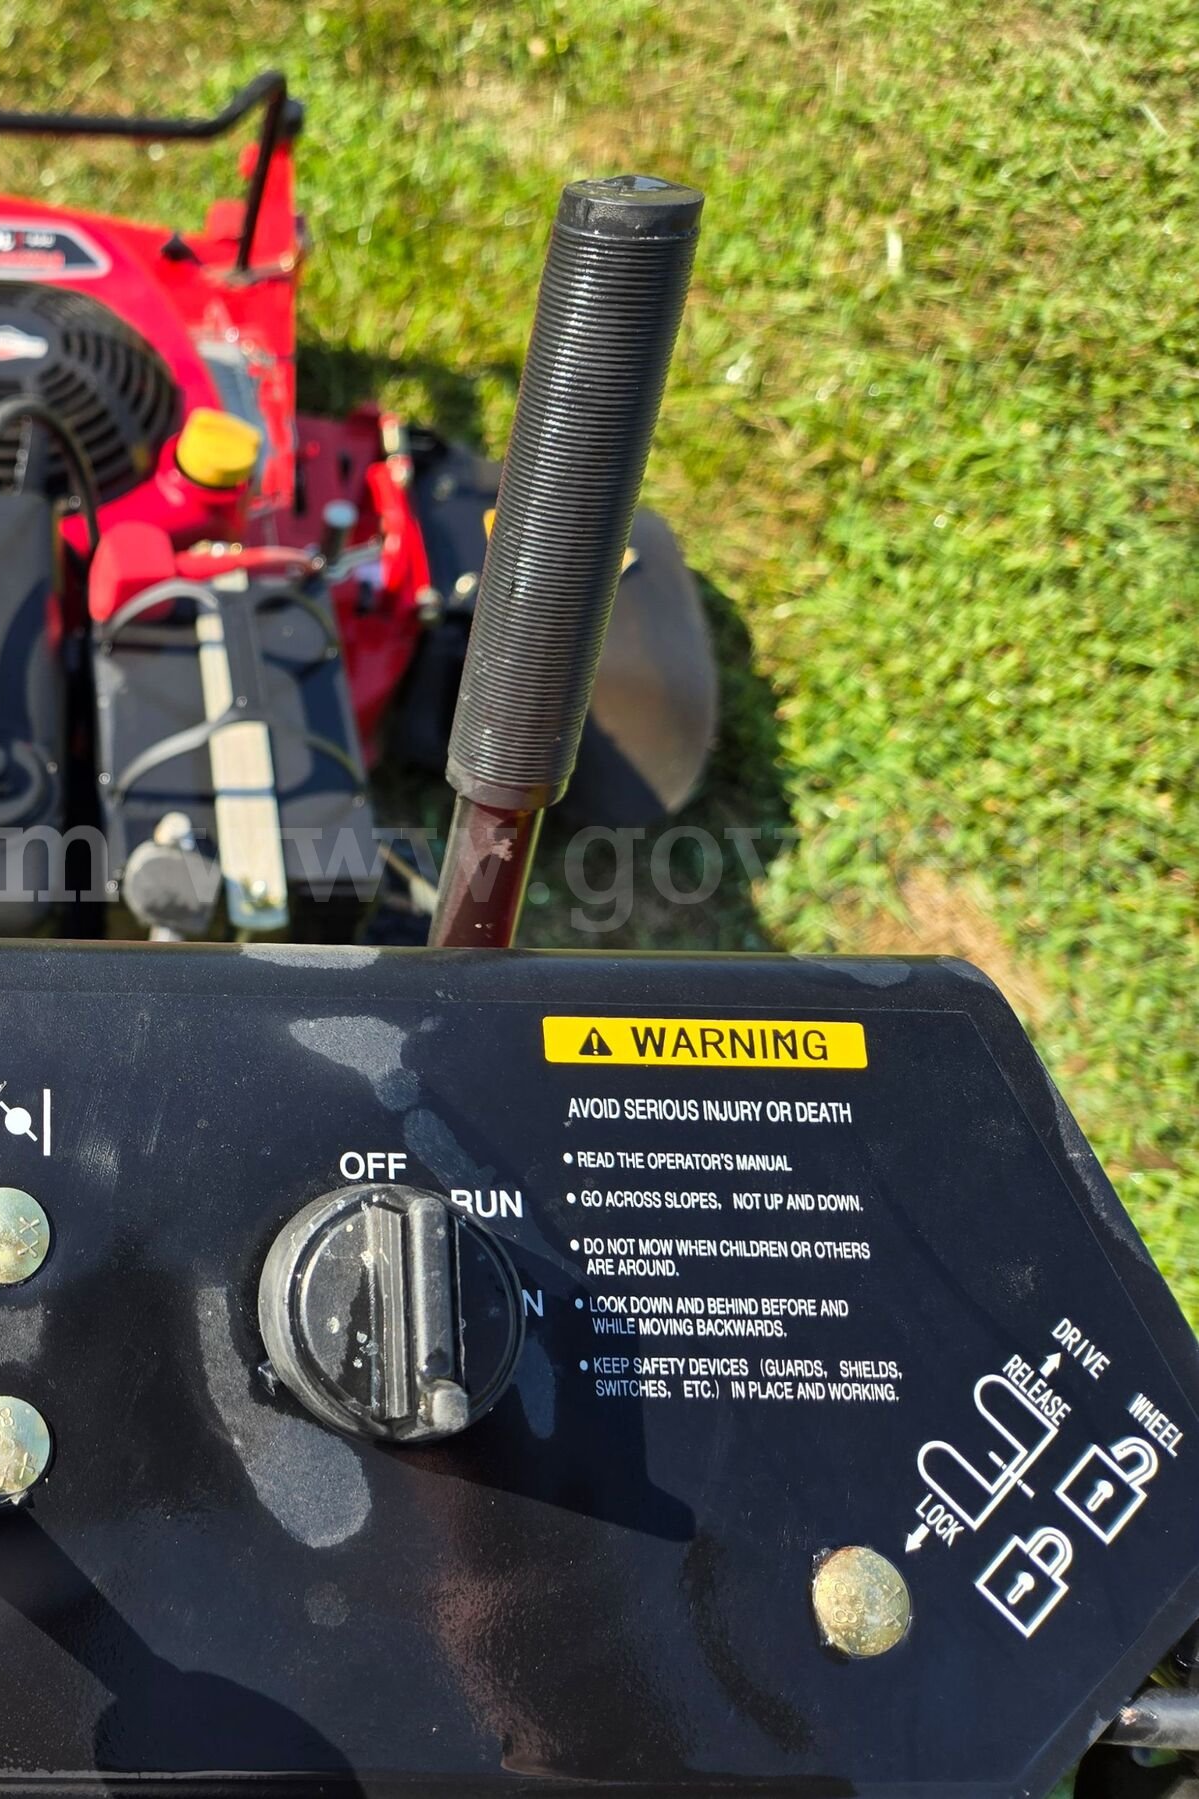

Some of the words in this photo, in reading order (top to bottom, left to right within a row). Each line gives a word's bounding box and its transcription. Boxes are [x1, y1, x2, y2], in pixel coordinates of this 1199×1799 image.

[630, 1026, 828, 1061] WARNING
[568, 1097, 621, 1120] AVOID
[623, 1098, 700, 1122] SERIOUS
[702, 1099, 763, 1122] INJURY
[766, 1100, 793, 1123] OR
[794, 1101, 853, 1124] DEATH
[339, 1152, 407, 1180] OFF
[576, 1151, 615, 1169] READ
[616, 1151, 645, 1169] THE
[646, 1152, 734, 1171] OPERATOR'S
[735, 1154, 793, 1172] MANUAL
[450, 1189, 524, 1218] RUN
[580, 1190, 603, 1208] GO
[605, 1191, 663, 1209] ACROSS
[664, 1191, 722, 1211] SLOPES,
[732, 1192, 762, 1210] NOT
[763, 1193, 784, 1211] UP
[786, 1193, 816, 1211] AND
[817, 1193, 864, 1212] DOWN.
[583, 1237, 605, 1256] DO
[606, 1237, 636, 1256] NOT
[638, 1238, 674, 1257] MOW
[674, 1238, 718, 1257] WHEN
[719, 1239, 789, 1258] CHILDREN
[790, 1240, 813, 1259] OR
[813, 1241, 871, 1260] OTHERS
[586, 1258, 616, 1276] ARE
[617, 1258, 680, 1277] AROUND.
[589, 1295, 628, 1314] LOOK
[629, 1295, 674, 1315] DOWN
[675, 1296, 705, 1315] AND
[706, 1297, 759, 1316] BEHIND
[760, 1297, 818, 1317] BEFORE
[820, 1299, 849, 1318] AND
[592, 1317, 636, 1334] WHILE
[638, 1317, 694, 1337] MOVING
[695, 1318, 788, 1338] BACKWARDS.
[1051, 1317, 1111, 1379] DRIVE
[593, 1357, 630, 1374] KEEP
[633, 1357, 686, 1376] SAFETY
[688, 1357, 750, 1377] DEVICES
[759, 1358, 828, 1379] (GUARDS,
[839, 1360, 903, 1380] SHIELDS,
[595, 1379, 672, 1399] SWITCHES,
[682, 1379, 720, 1399] ETC.)
[730, 1381, 746, 1399] IN
[747, 1381, 795, 1400] PLACE
[796, 1381, 826, 1401] AND
[827, 1382, 900, 1402] WORKING.
[1002, 1354, 1072, 1428] RELEASE
[1128, 1392, 1184, 1457] WHEEL
[915, 1493, 965, 1547] LOCK
